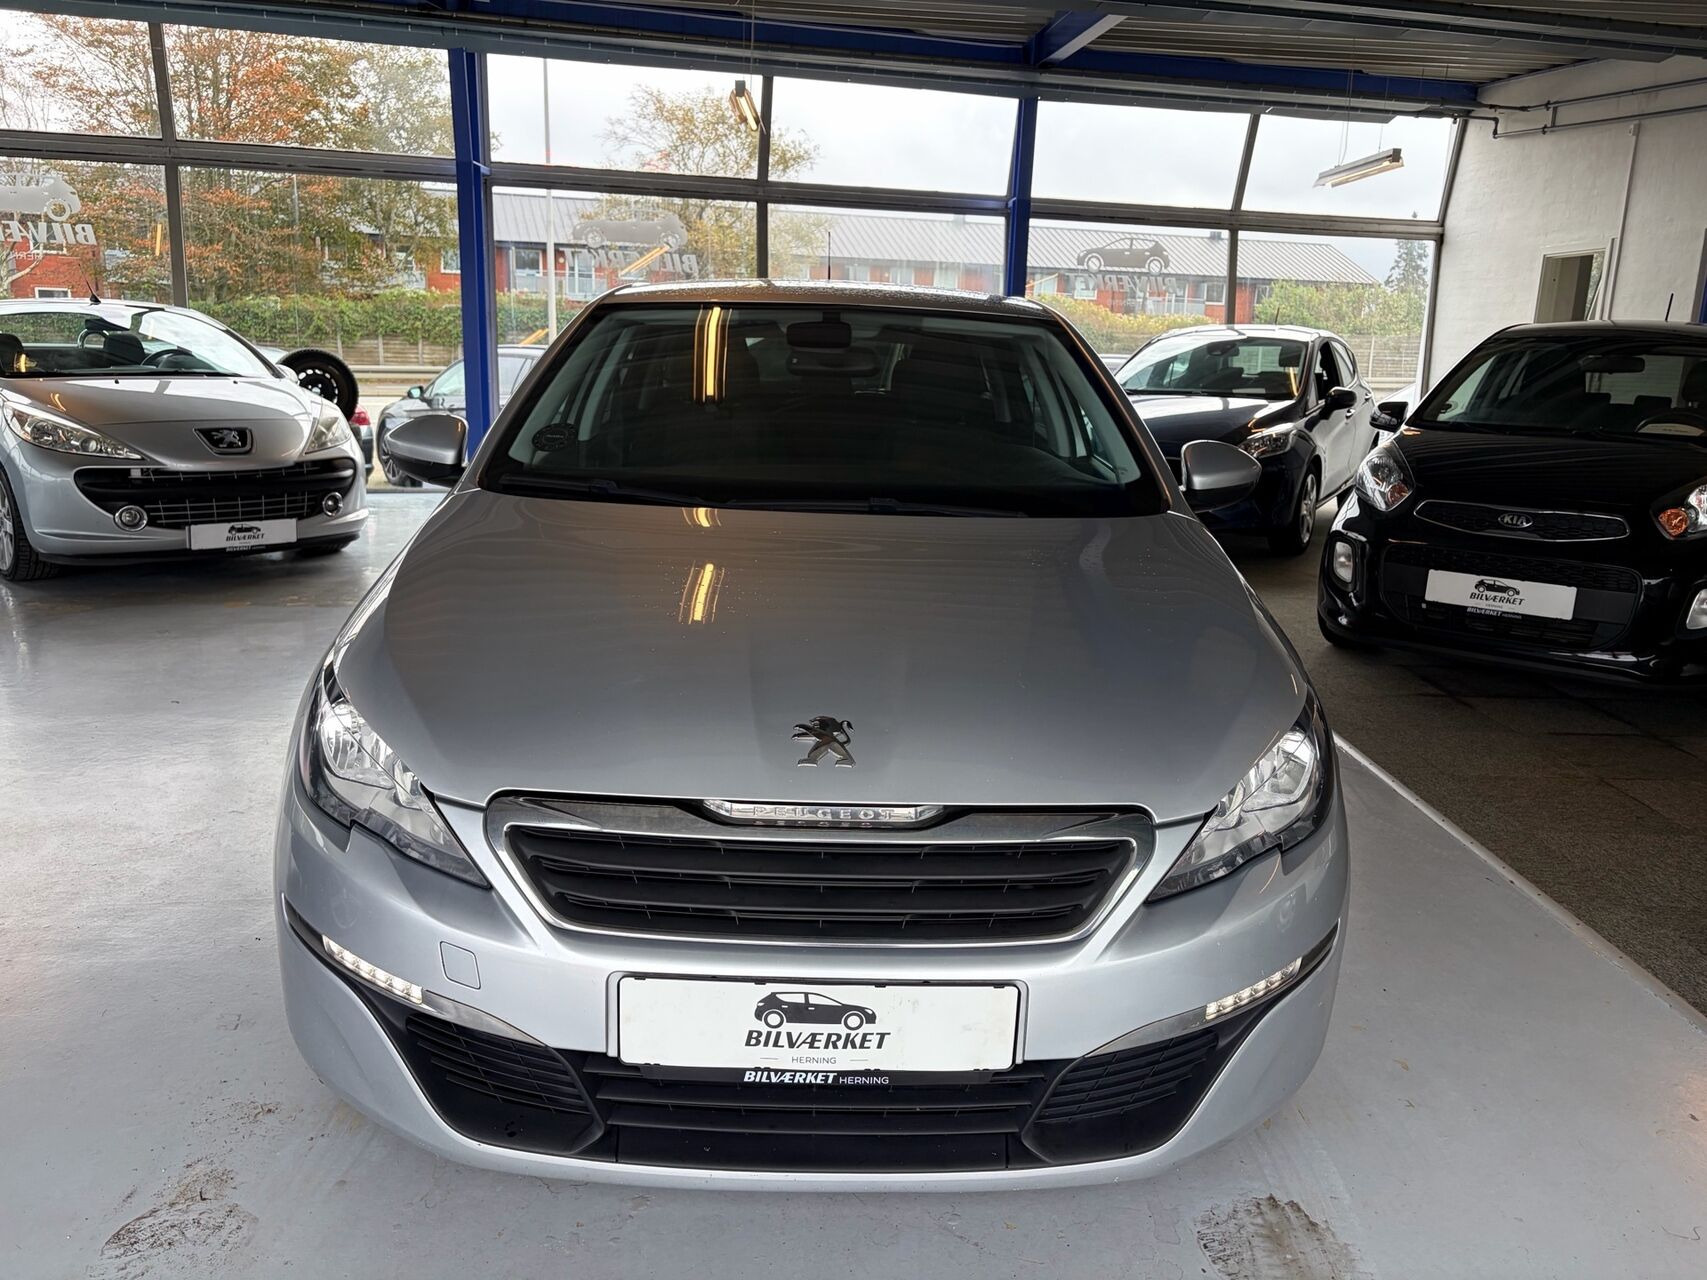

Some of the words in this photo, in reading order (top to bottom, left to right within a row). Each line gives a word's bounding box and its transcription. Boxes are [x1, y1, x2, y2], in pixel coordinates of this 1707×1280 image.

[1503, 514, 1528, 526] KIA
[1469, 592, 1526, 606] BILVÆRKET
[753, 805, 895, 820] PEUGEOT
[744, 1029, 891, 1050] BILVÆRKET
[791, 1056, 837, 1064] HERNING
[743, 1070, 838, 1084] BILVÆRKET
[839, 1076, 889, 1085] HERNING
